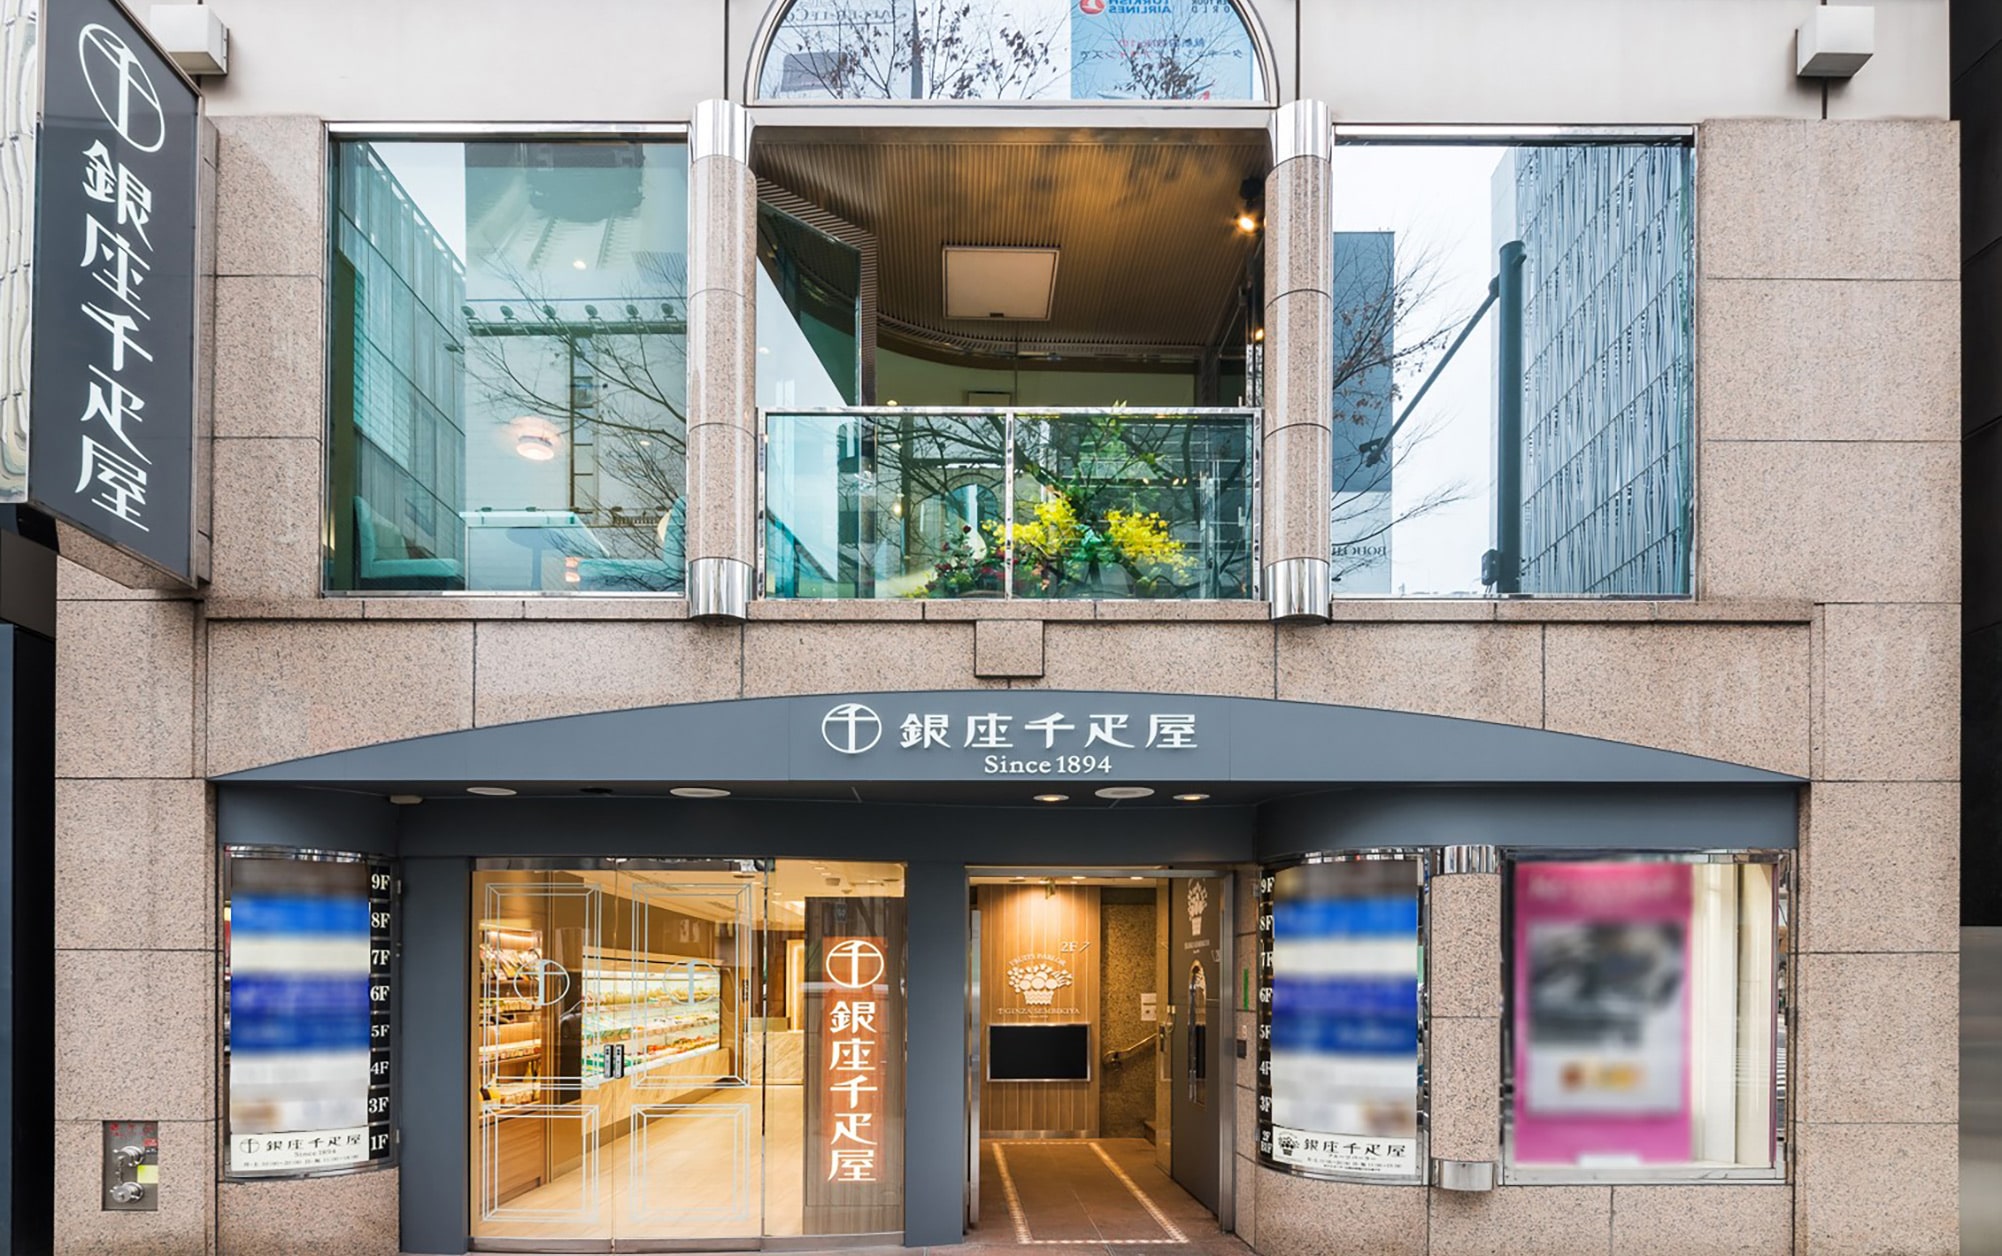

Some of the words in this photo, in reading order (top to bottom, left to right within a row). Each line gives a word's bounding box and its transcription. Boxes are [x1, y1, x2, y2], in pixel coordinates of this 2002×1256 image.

[75, 139, 154, 532] 銀座千疋屋
[899, 712, 1198, 750] 銀座千疋屋
[984, 755, 1051, 774] Since
[1056, 755, 1112, 774] 1894
[371, 874, 390, 890] 9F
[371, 912, 390, 928] 8F
[371, 949, 390, 966] 7F
[370, 985, 390, 1001] 6F
[371, 1024, 390, 1038] 5F
[369, 1061, 389, 1075] 4F
[827, 1000, 878, 1182] 銀座千疋屋
[368, 1097, 389, 1113] 3F
[266, 1134, 361, 1151] 銀座千疋屋
[370, 1133, 389, 1150] 1F
[1304, 1138, 1406, 1158] 銀座千疋屋
